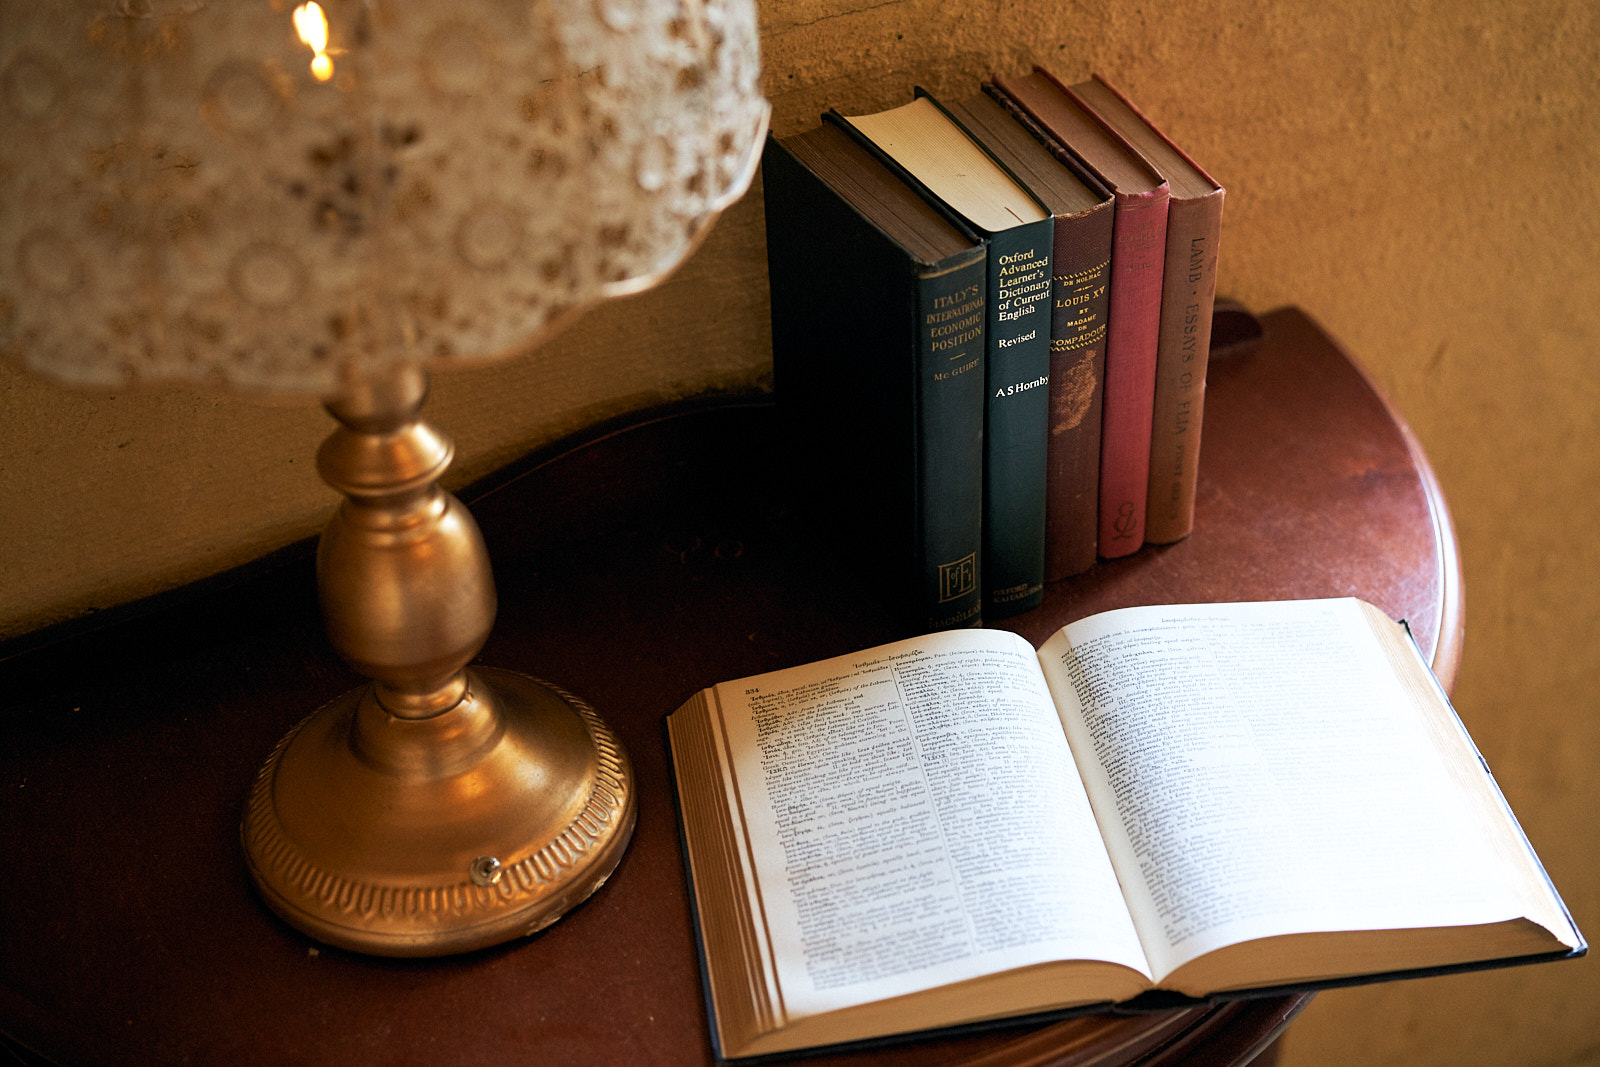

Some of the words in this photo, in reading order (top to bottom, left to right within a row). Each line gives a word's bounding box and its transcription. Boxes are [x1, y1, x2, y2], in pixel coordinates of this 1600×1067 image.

[999, 249, 1034, 265] Oxford
[999, 256, 1048, 277] Advanced
[1188, 237, 1205, 283] LAMB
[999, 269, 1044, 288] Learner's
[999, 279, 1051, 300] Dictionary
[934, 284, 979, 309] ITALY'S
[998, 300, 1010, 311] of
[1013, 289, 1050, 308] Current
[1056, 294, 1090, 308] LOUIS
[1092, 286, 1106, 300] XV
[926, 297, 984, 324] INTERNATIONAL
[998, 305, 1035, 322] English
[1067, 314, 1097, 328] MADAME
[931, 312, 981, 338] ECONOMIC
[1181, 304, 1199, 364] ESSAYS
[932, 326, 981, 352] POSITION
[998, 330, 1036, 349] Revised
[995, 388, 1005, 398] A
[1007, 386, 1014, 395] S
[1015, 375, 1049, 393] Hornby
[1179, 372, 1193, 393] OF
